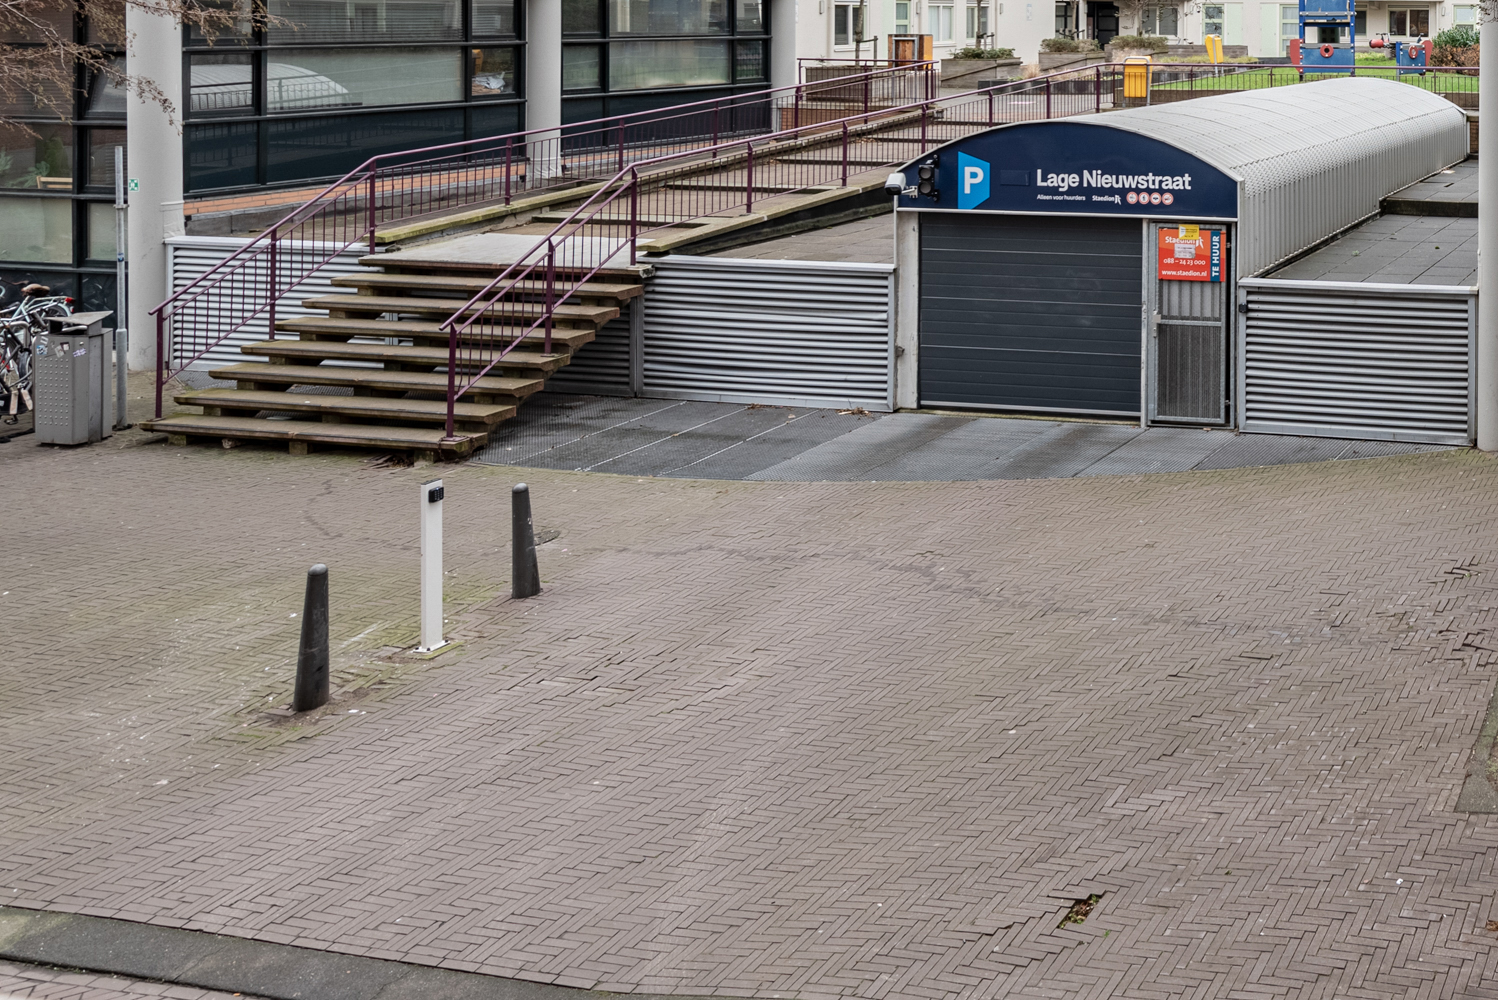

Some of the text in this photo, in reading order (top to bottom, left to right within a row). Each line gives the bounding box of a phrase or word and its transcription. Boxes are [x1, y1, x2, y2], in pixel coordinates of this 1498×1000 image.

[964, 166, 984, 194] P
[1036, 169, 1192, 192] Lage Nieuwstraat
[1092, 194, 1115, 202] Staedion
[1212, 236, 1220, 277] TE HUUR
